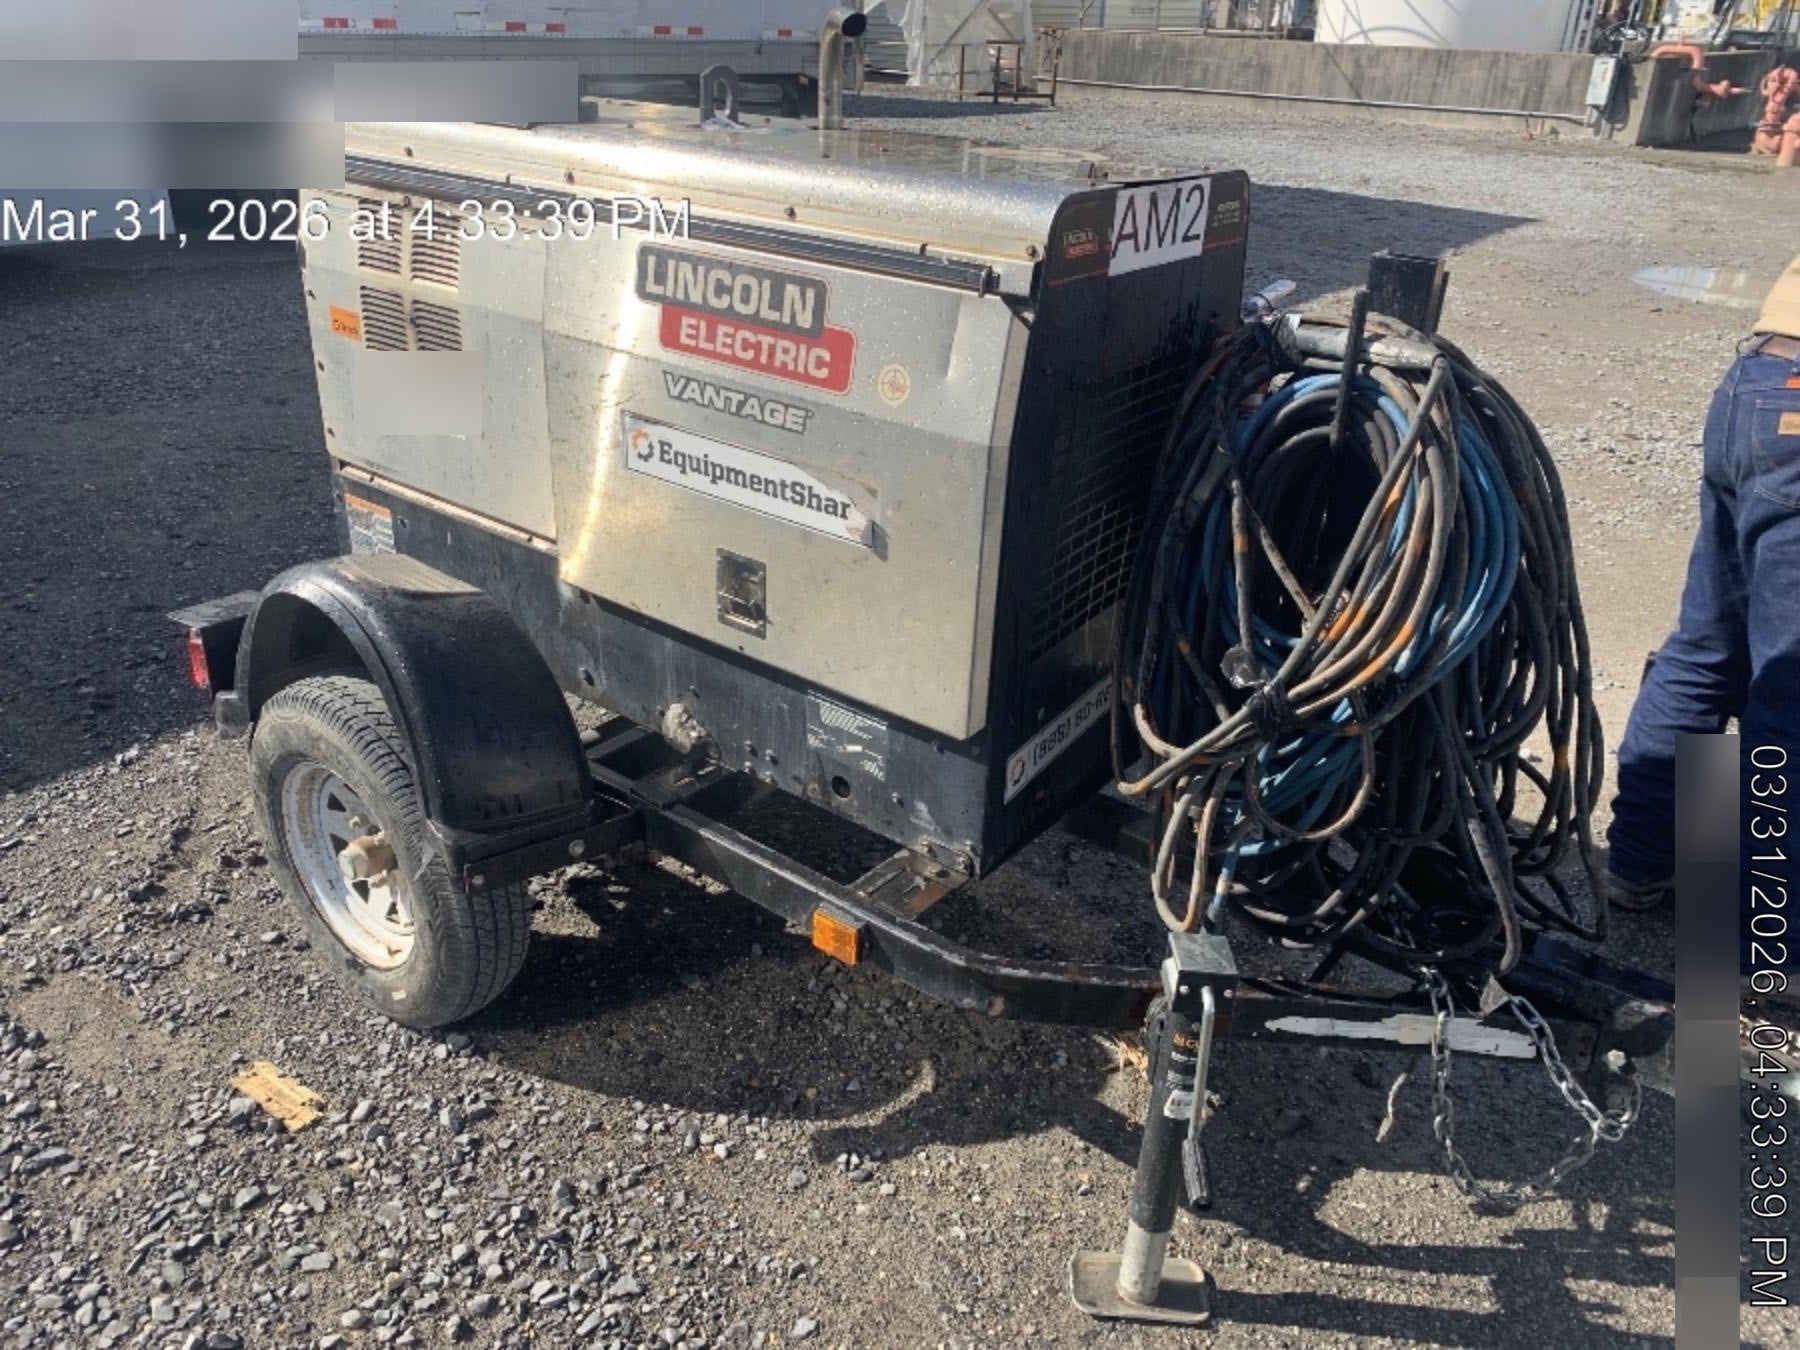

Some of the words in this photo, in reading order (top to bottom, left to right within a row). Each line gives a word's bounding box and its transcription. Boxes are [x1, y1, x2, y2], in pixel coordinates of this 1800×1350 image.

[1111, 184, 1205, 258] AM2
[645, 255, 816, 329] LINCOLN
[679, 316, 831, 379] ELECTRIC
[662, 370, 810, 434] VANTAGE
